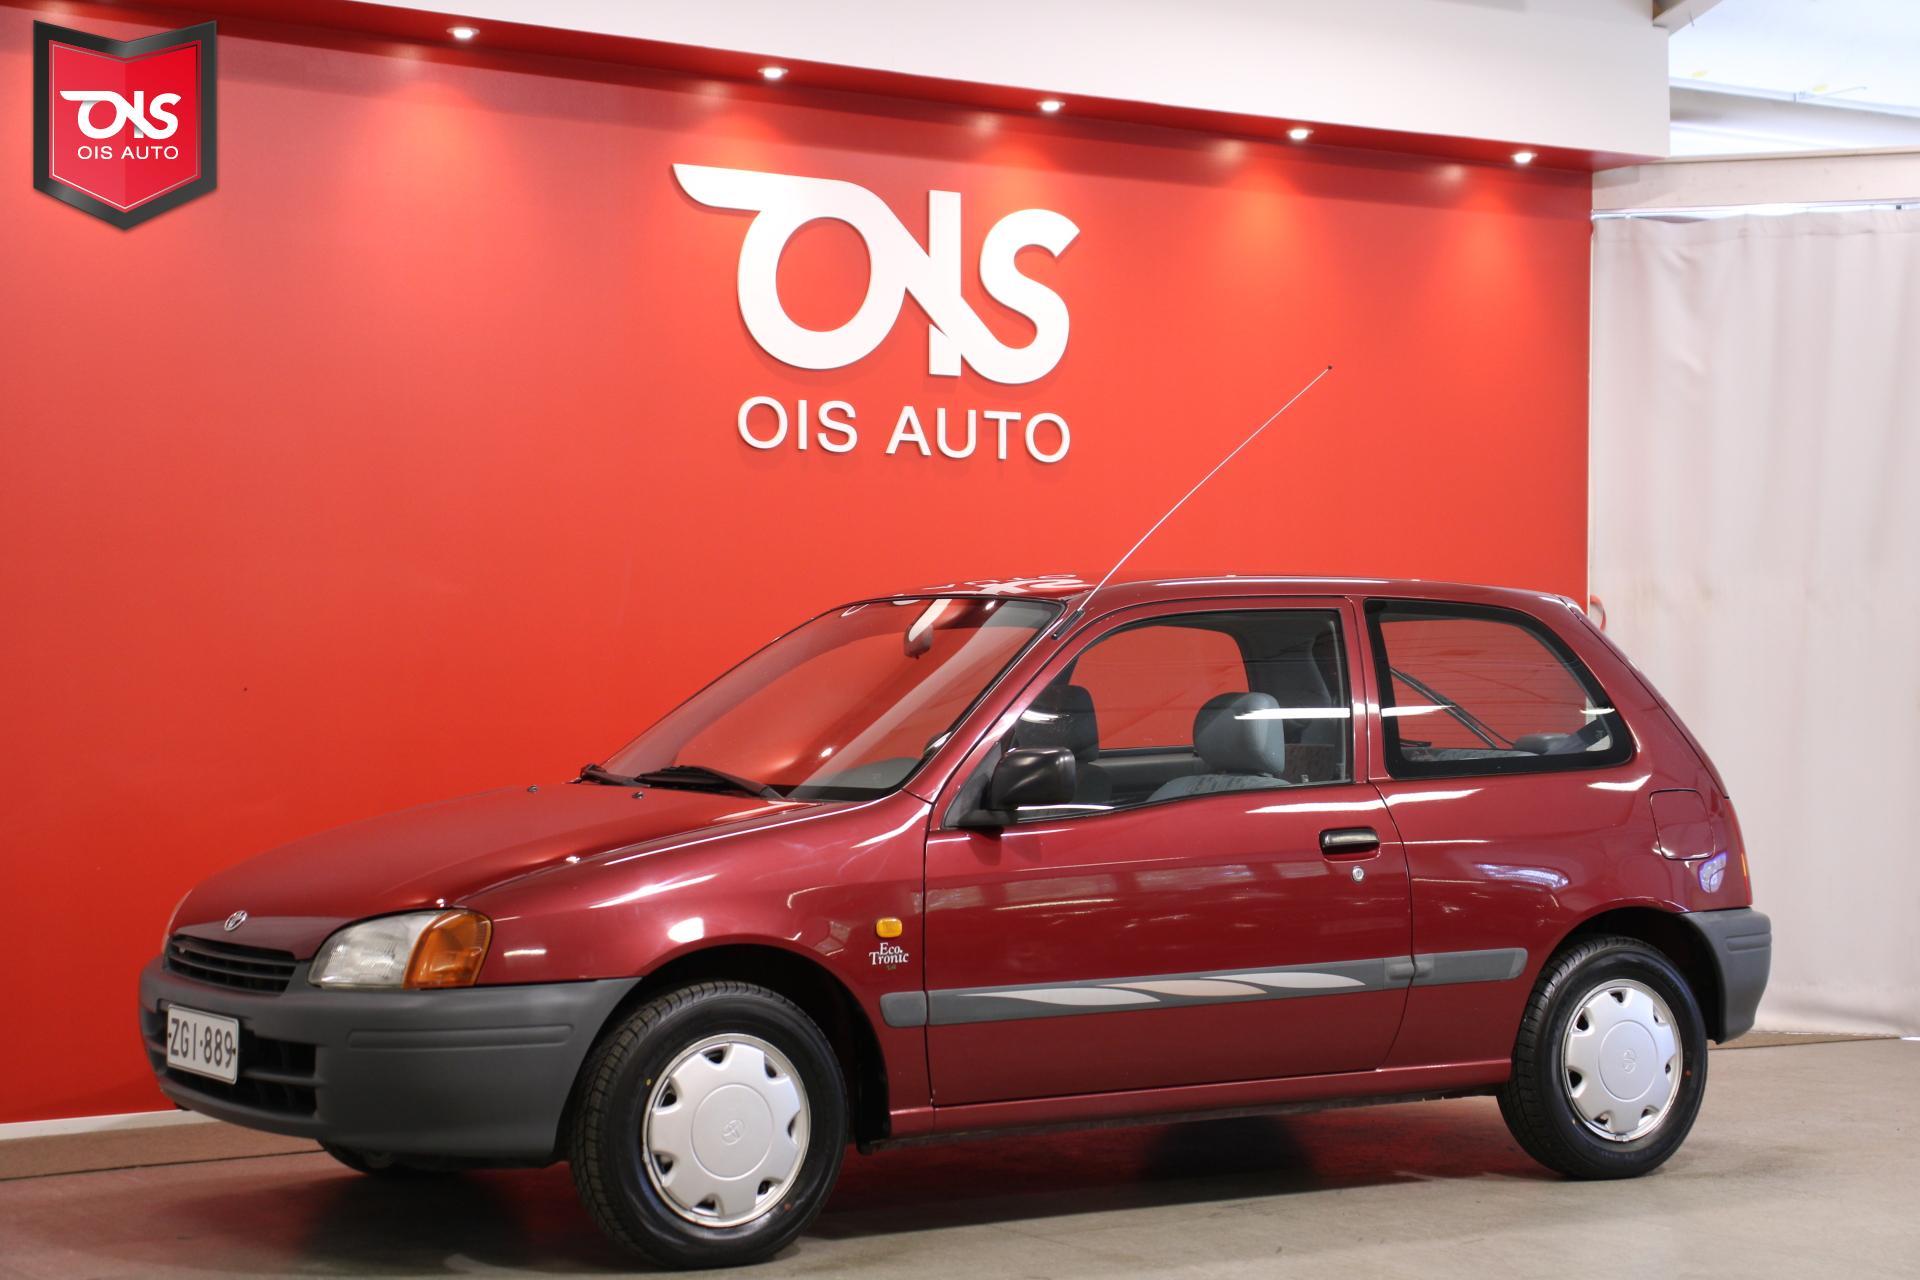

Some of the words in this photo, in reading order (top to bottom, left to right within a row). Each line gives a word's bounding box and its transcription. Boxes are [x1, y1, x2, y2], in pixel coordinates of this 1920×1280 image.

[672, 163, 1081, 385] OIS
[737, 395, 858, 454] OIS
[884, 405, 1071, 463] AUTO
[868, 950, 909, 965] Tronic
